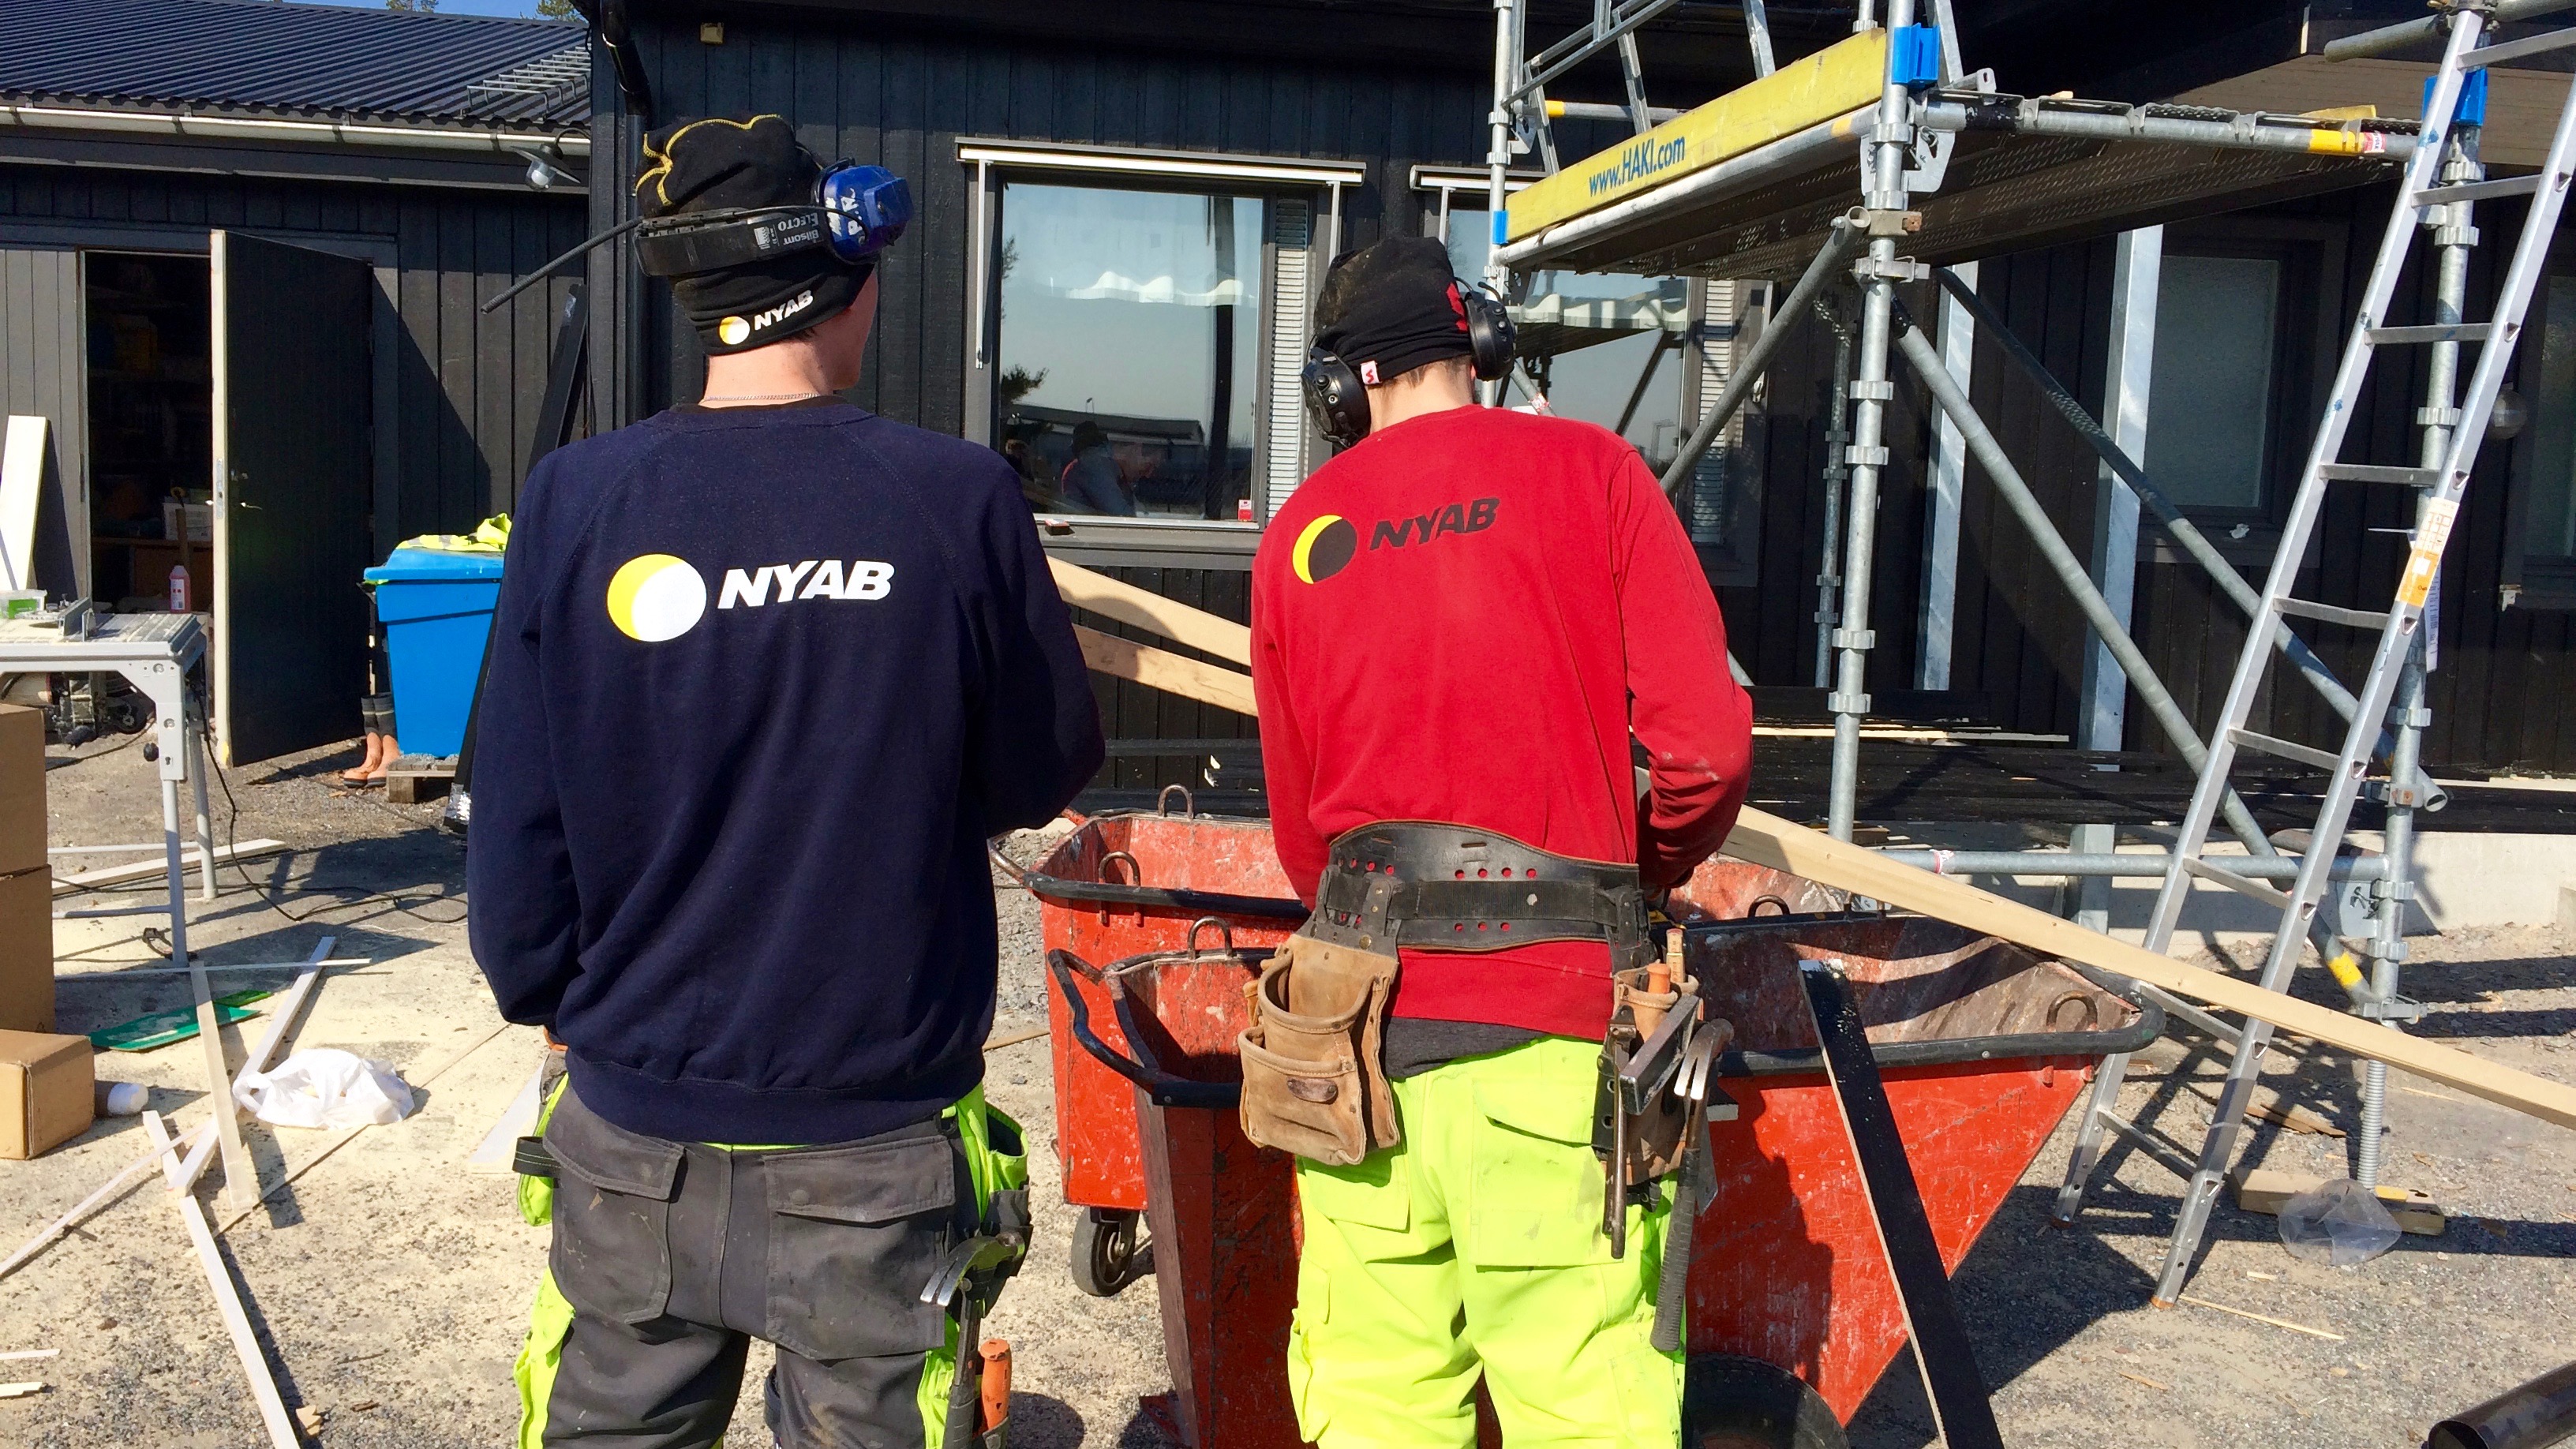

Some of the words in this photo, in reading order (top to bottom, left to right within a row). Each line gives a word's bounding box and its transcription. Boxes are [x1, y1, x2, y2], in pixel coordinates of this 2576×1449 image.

[1589, 136, 1686, 197] www.HAKI.com
[754, 290, 814, 331] NYAB
[1369, 496, 1500, 551] NYAB
[717, 560, 895, 609] NYAB
